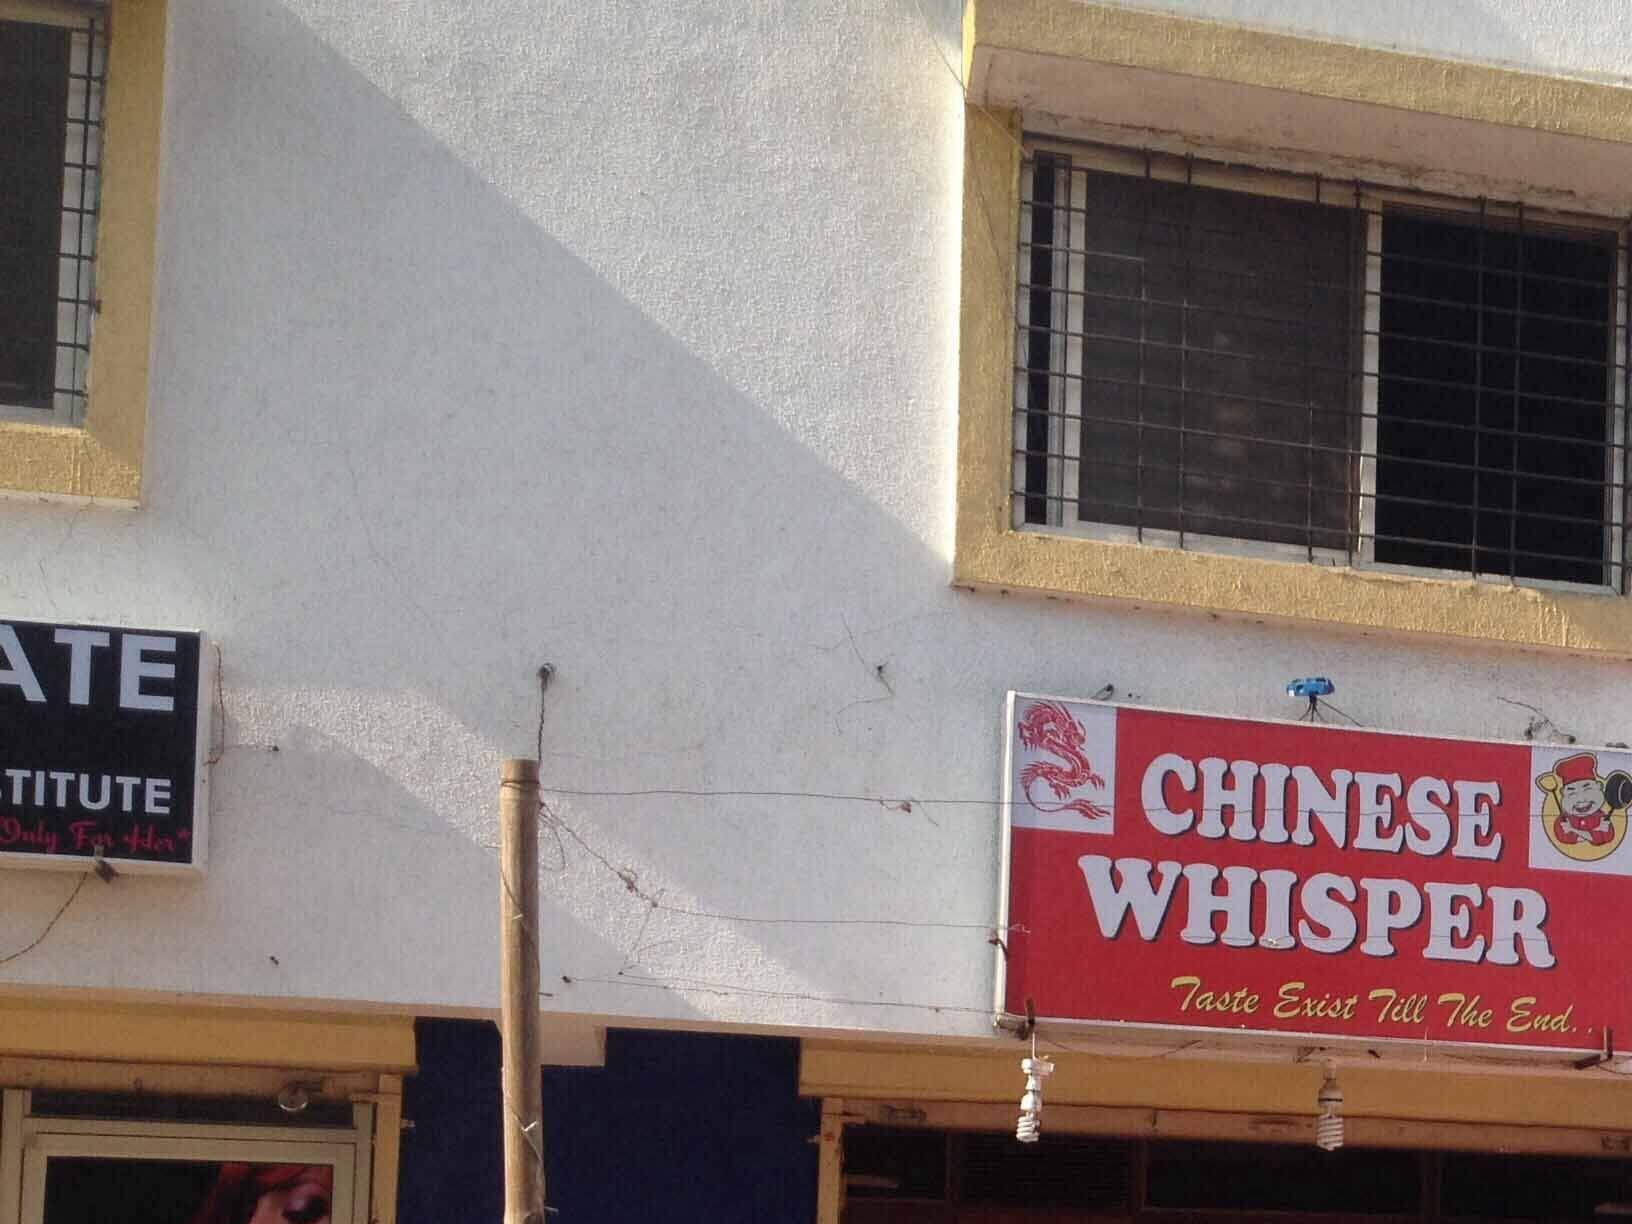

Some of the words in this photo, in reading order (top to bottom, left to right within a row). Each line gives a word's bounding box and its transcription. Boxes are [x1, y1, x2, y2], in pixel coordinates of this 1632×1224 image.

[0, 769, 171, 814] TITUTE
[1142, 753, 1503, 861] CHINESE
[1078, 855, 1556, 969] WHISPER
[1171, 976, 1258, 1012] Taste
[1273, 982, 1358, 1020] Exist
[1368, 989, 1425, 1023] Till
[1438, 993, 1492, 1027] The
